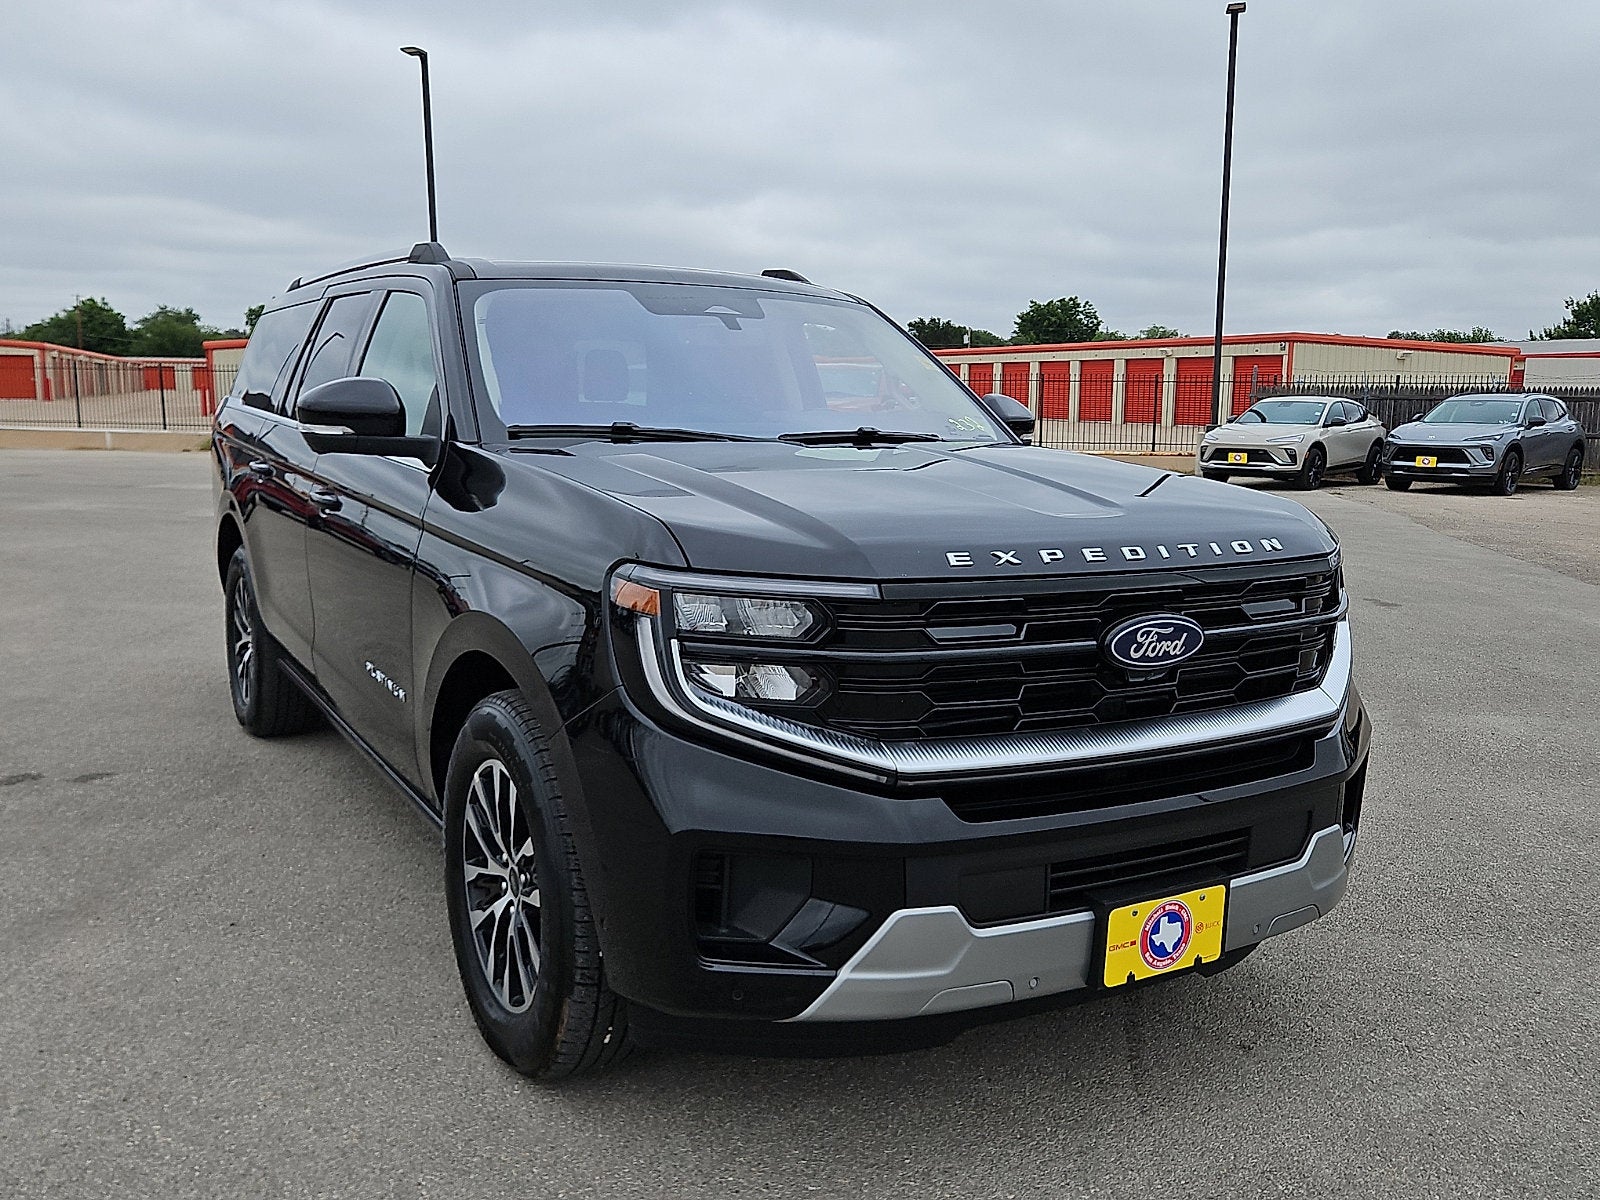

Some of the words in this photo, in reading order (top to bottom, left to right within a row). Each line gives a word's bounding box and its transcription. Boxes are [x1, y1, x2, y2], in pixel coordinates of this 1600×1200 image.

[945, 537, 1284, 568] EXPEDITION
[1129, 626, 1188, 660] Ford
[1108, 941, 1130, 952] GMC
